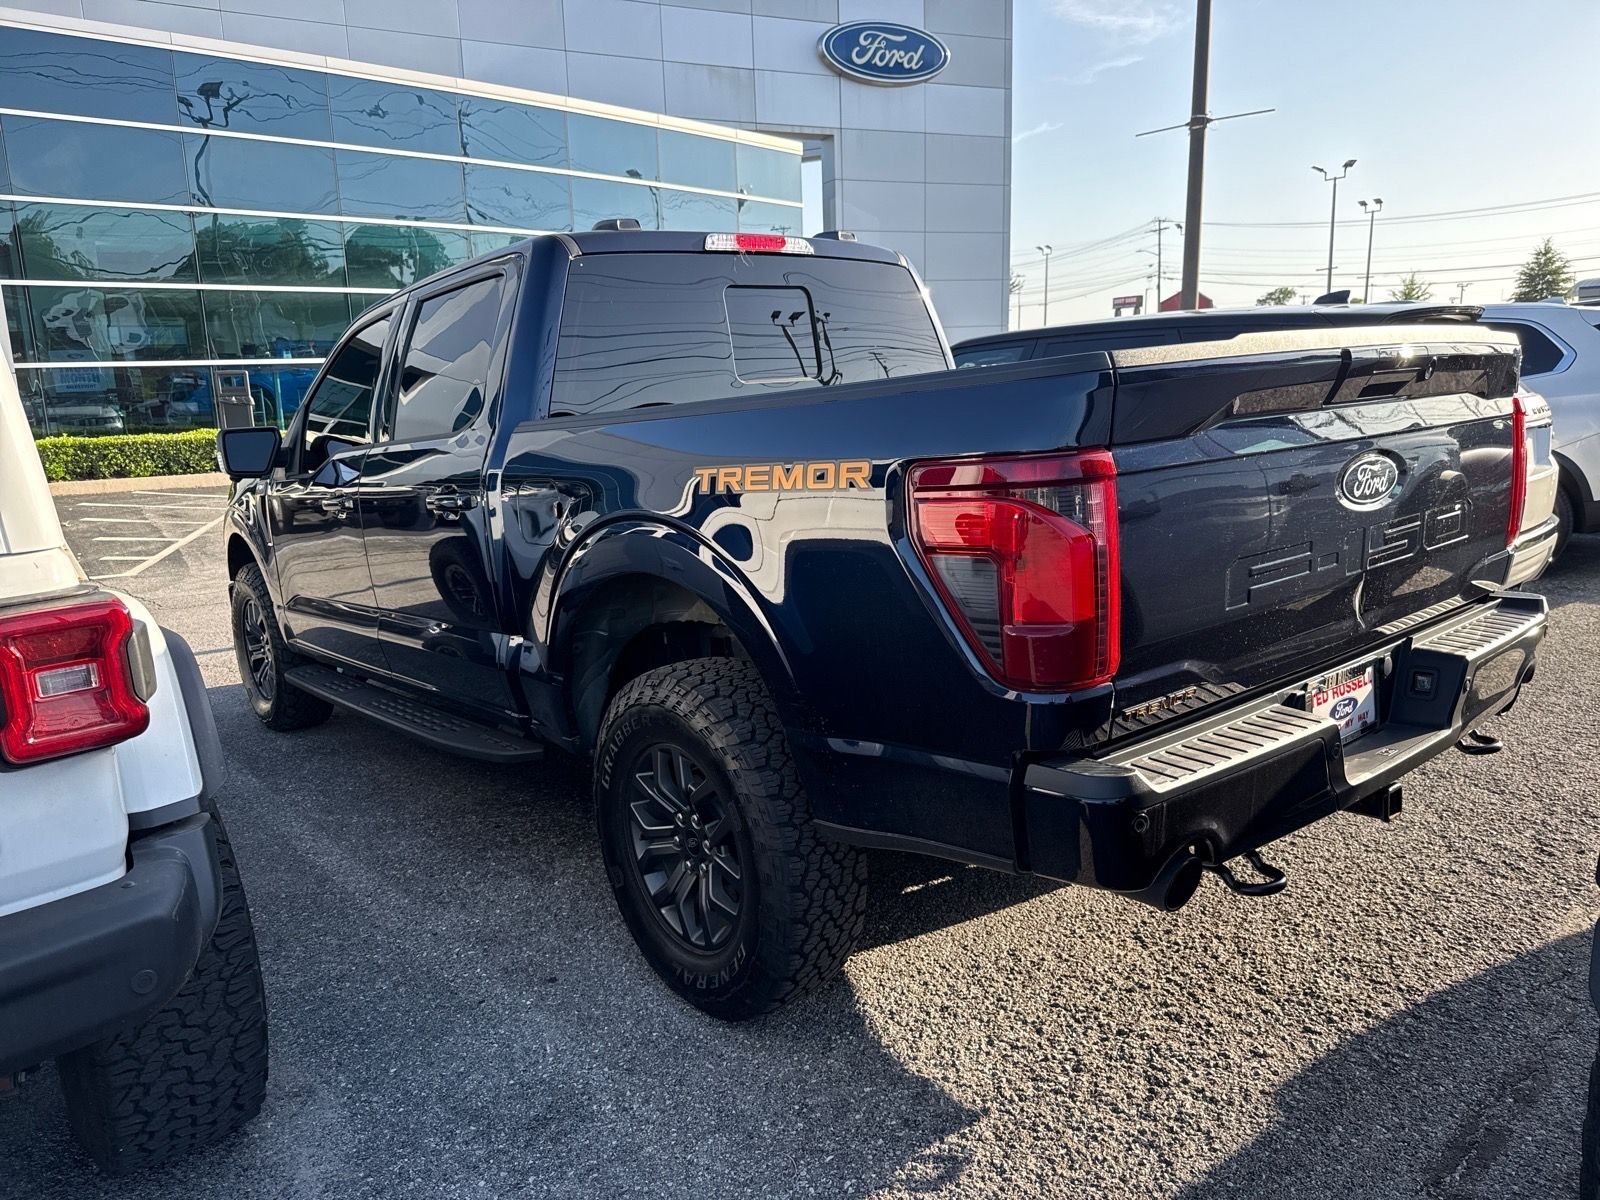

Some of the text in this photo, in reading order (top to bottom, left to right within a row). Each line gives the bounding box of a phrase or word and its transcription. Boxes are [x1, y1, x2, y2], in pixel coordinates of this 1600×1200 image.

[851, 30, 925, 70] Ford
[694, 459, 874, 494] TREMOR
[1353, 463, 1390, 497] Ford
[1225, 498, 1471, 611] F-150
[1312, 673, 1373, 706] TED RUSSELL
[1335, 699, 1354, 719] Ford
[601, 714, 651, 790] GRABBER
[672, 942, 746, 989] GENERAL
